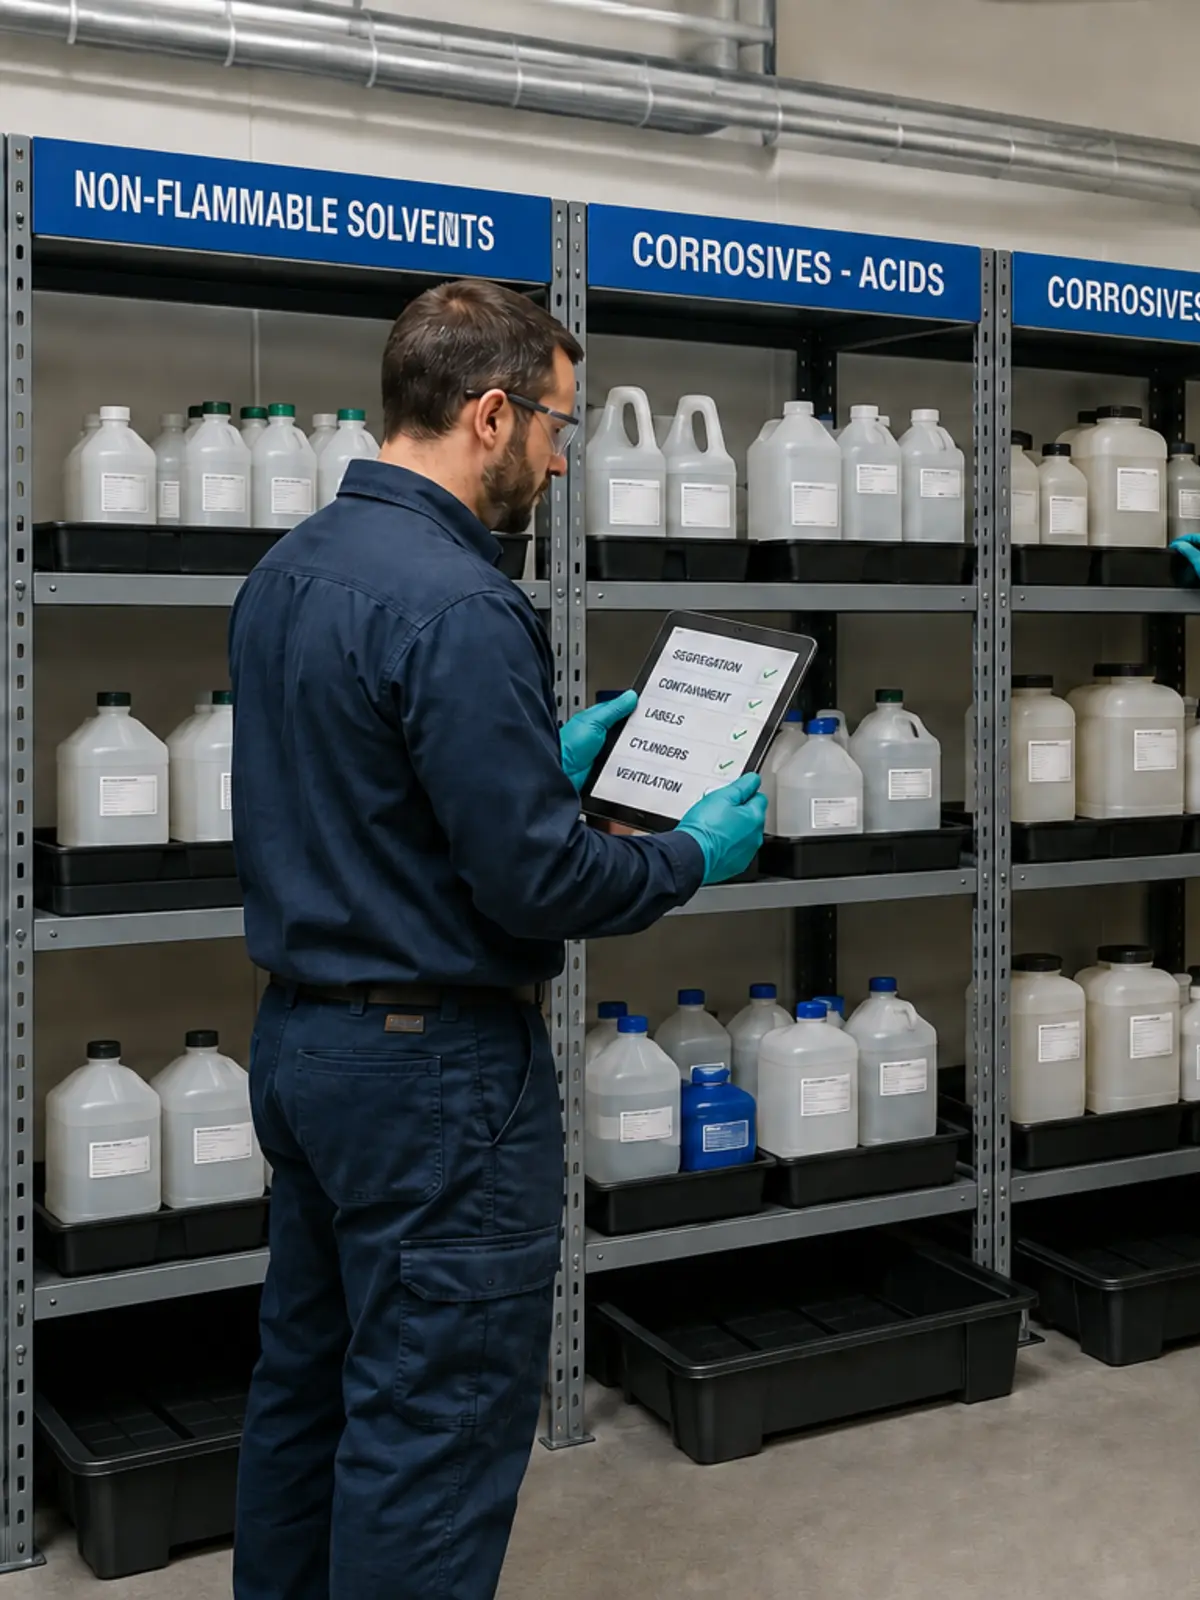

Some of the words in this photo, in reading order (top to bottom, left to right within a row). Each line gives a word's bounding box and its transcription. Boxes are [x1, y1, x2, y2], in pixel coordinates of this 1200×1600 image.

[75, 170, 338, 234] NON-FLAMMABLE
[347, 200, 495, 251] SOLVENTS
[632, 231, 832, 285] CORROSIVES
[859, 257, 945, 296] ACIDS
